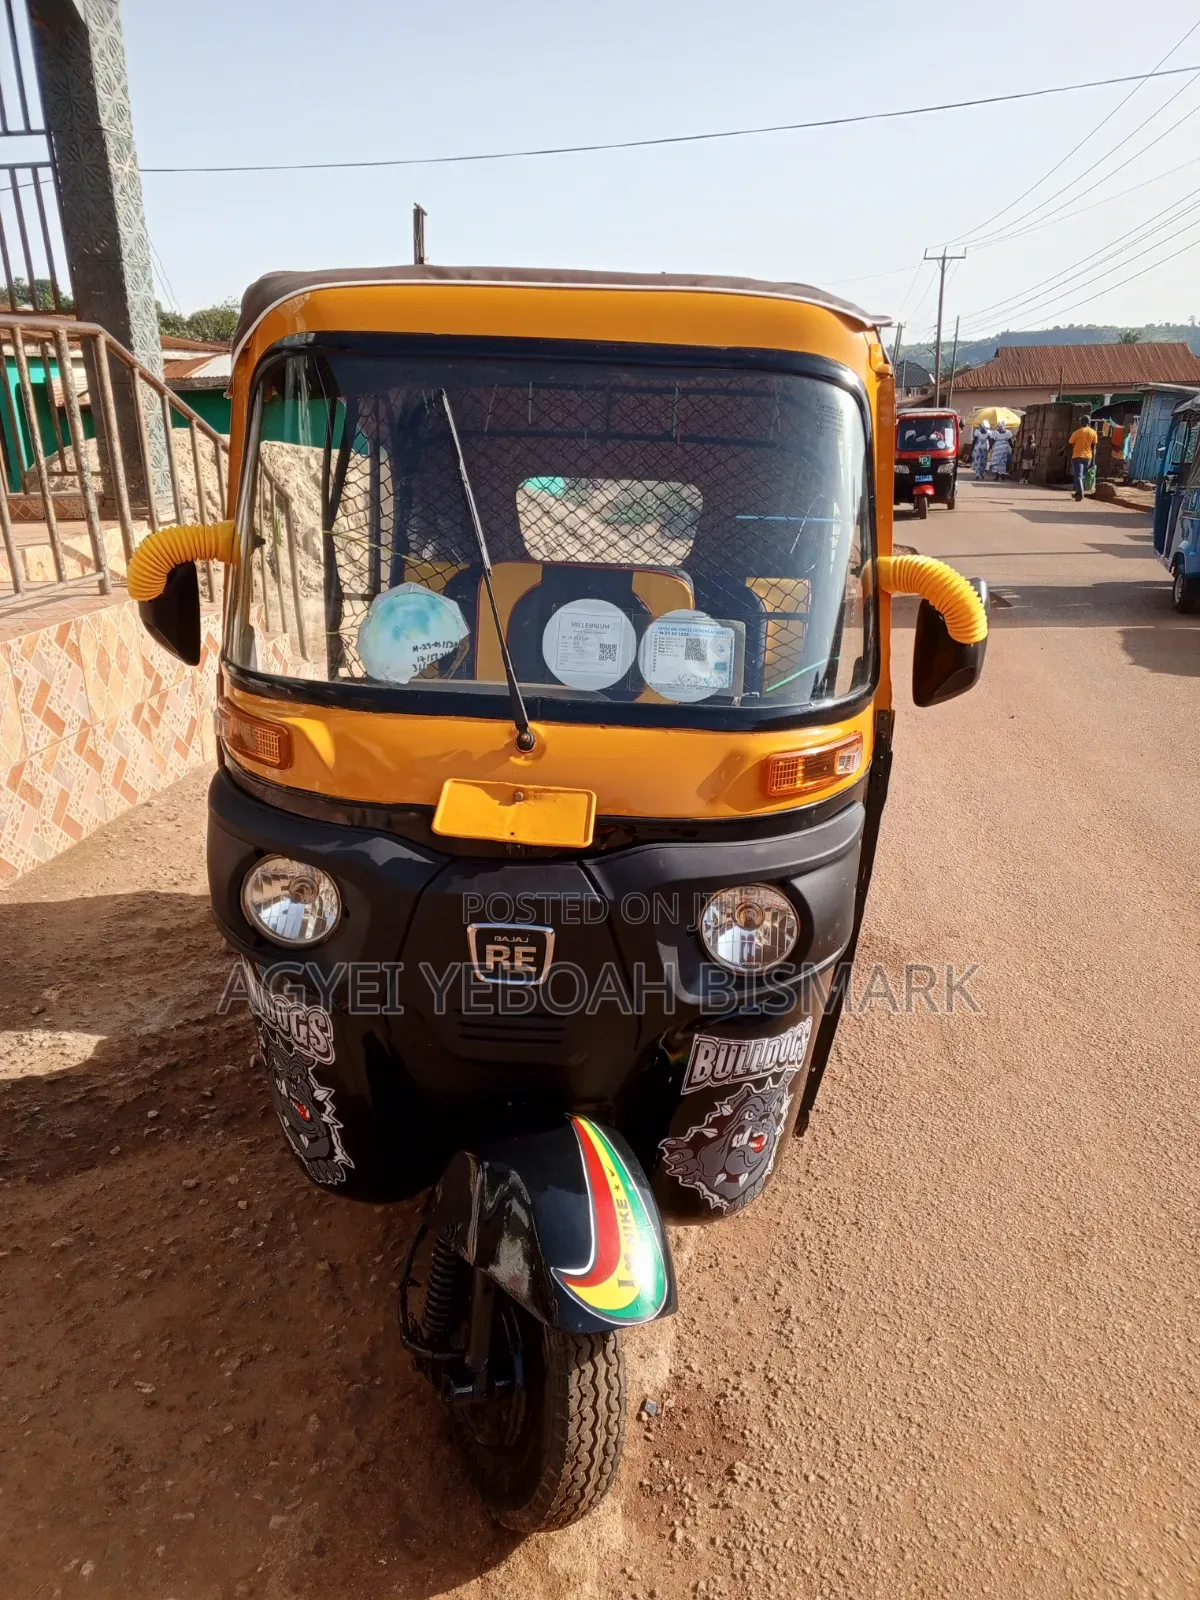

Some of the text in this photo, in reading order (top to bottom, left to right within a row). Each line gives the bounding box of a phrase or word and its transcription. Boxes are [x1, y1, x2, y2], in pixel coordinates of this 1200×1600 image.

[570, 621, 610, 630] MILLENNIUM
[485, 945, 537, 972] RE
[687, 1020, 811, 1087] BULLDOGS
